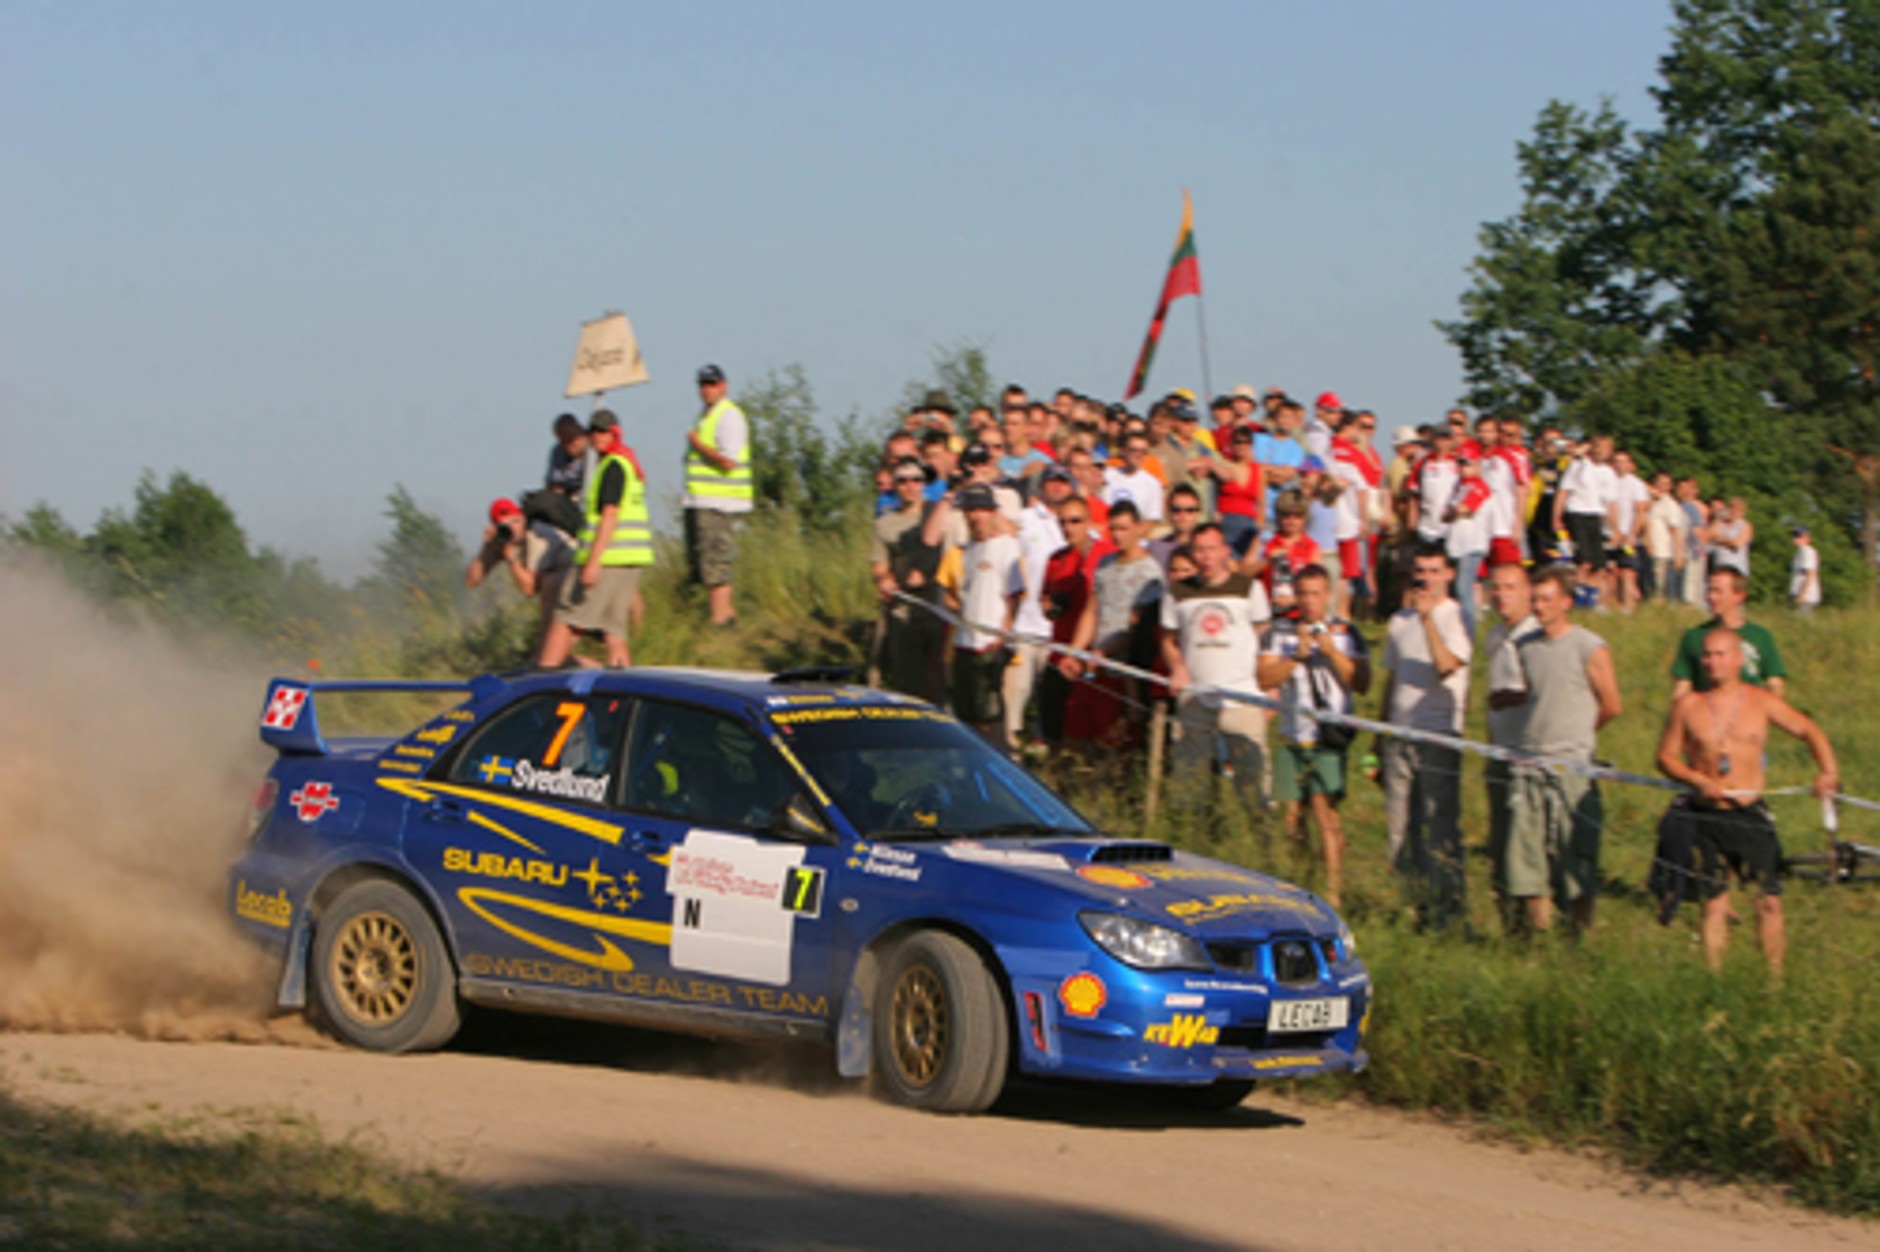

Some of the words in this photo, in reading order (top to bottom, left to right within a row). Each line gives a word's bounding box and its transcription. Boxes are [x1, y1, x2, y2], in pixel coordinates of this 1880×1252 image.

[541, 700, 587, 768] 7
[510, 758, 612, 803] Svedlund
[443, 847, 568, 887] SUBARU
[793, 868, 814, 911] 7
[683, 898, 701, 928] N
[466, 951, 604, 989] SWEDISH
[612, 970, 732, 1006] DEALER
[737, 985, 830, 1017] TEAM
